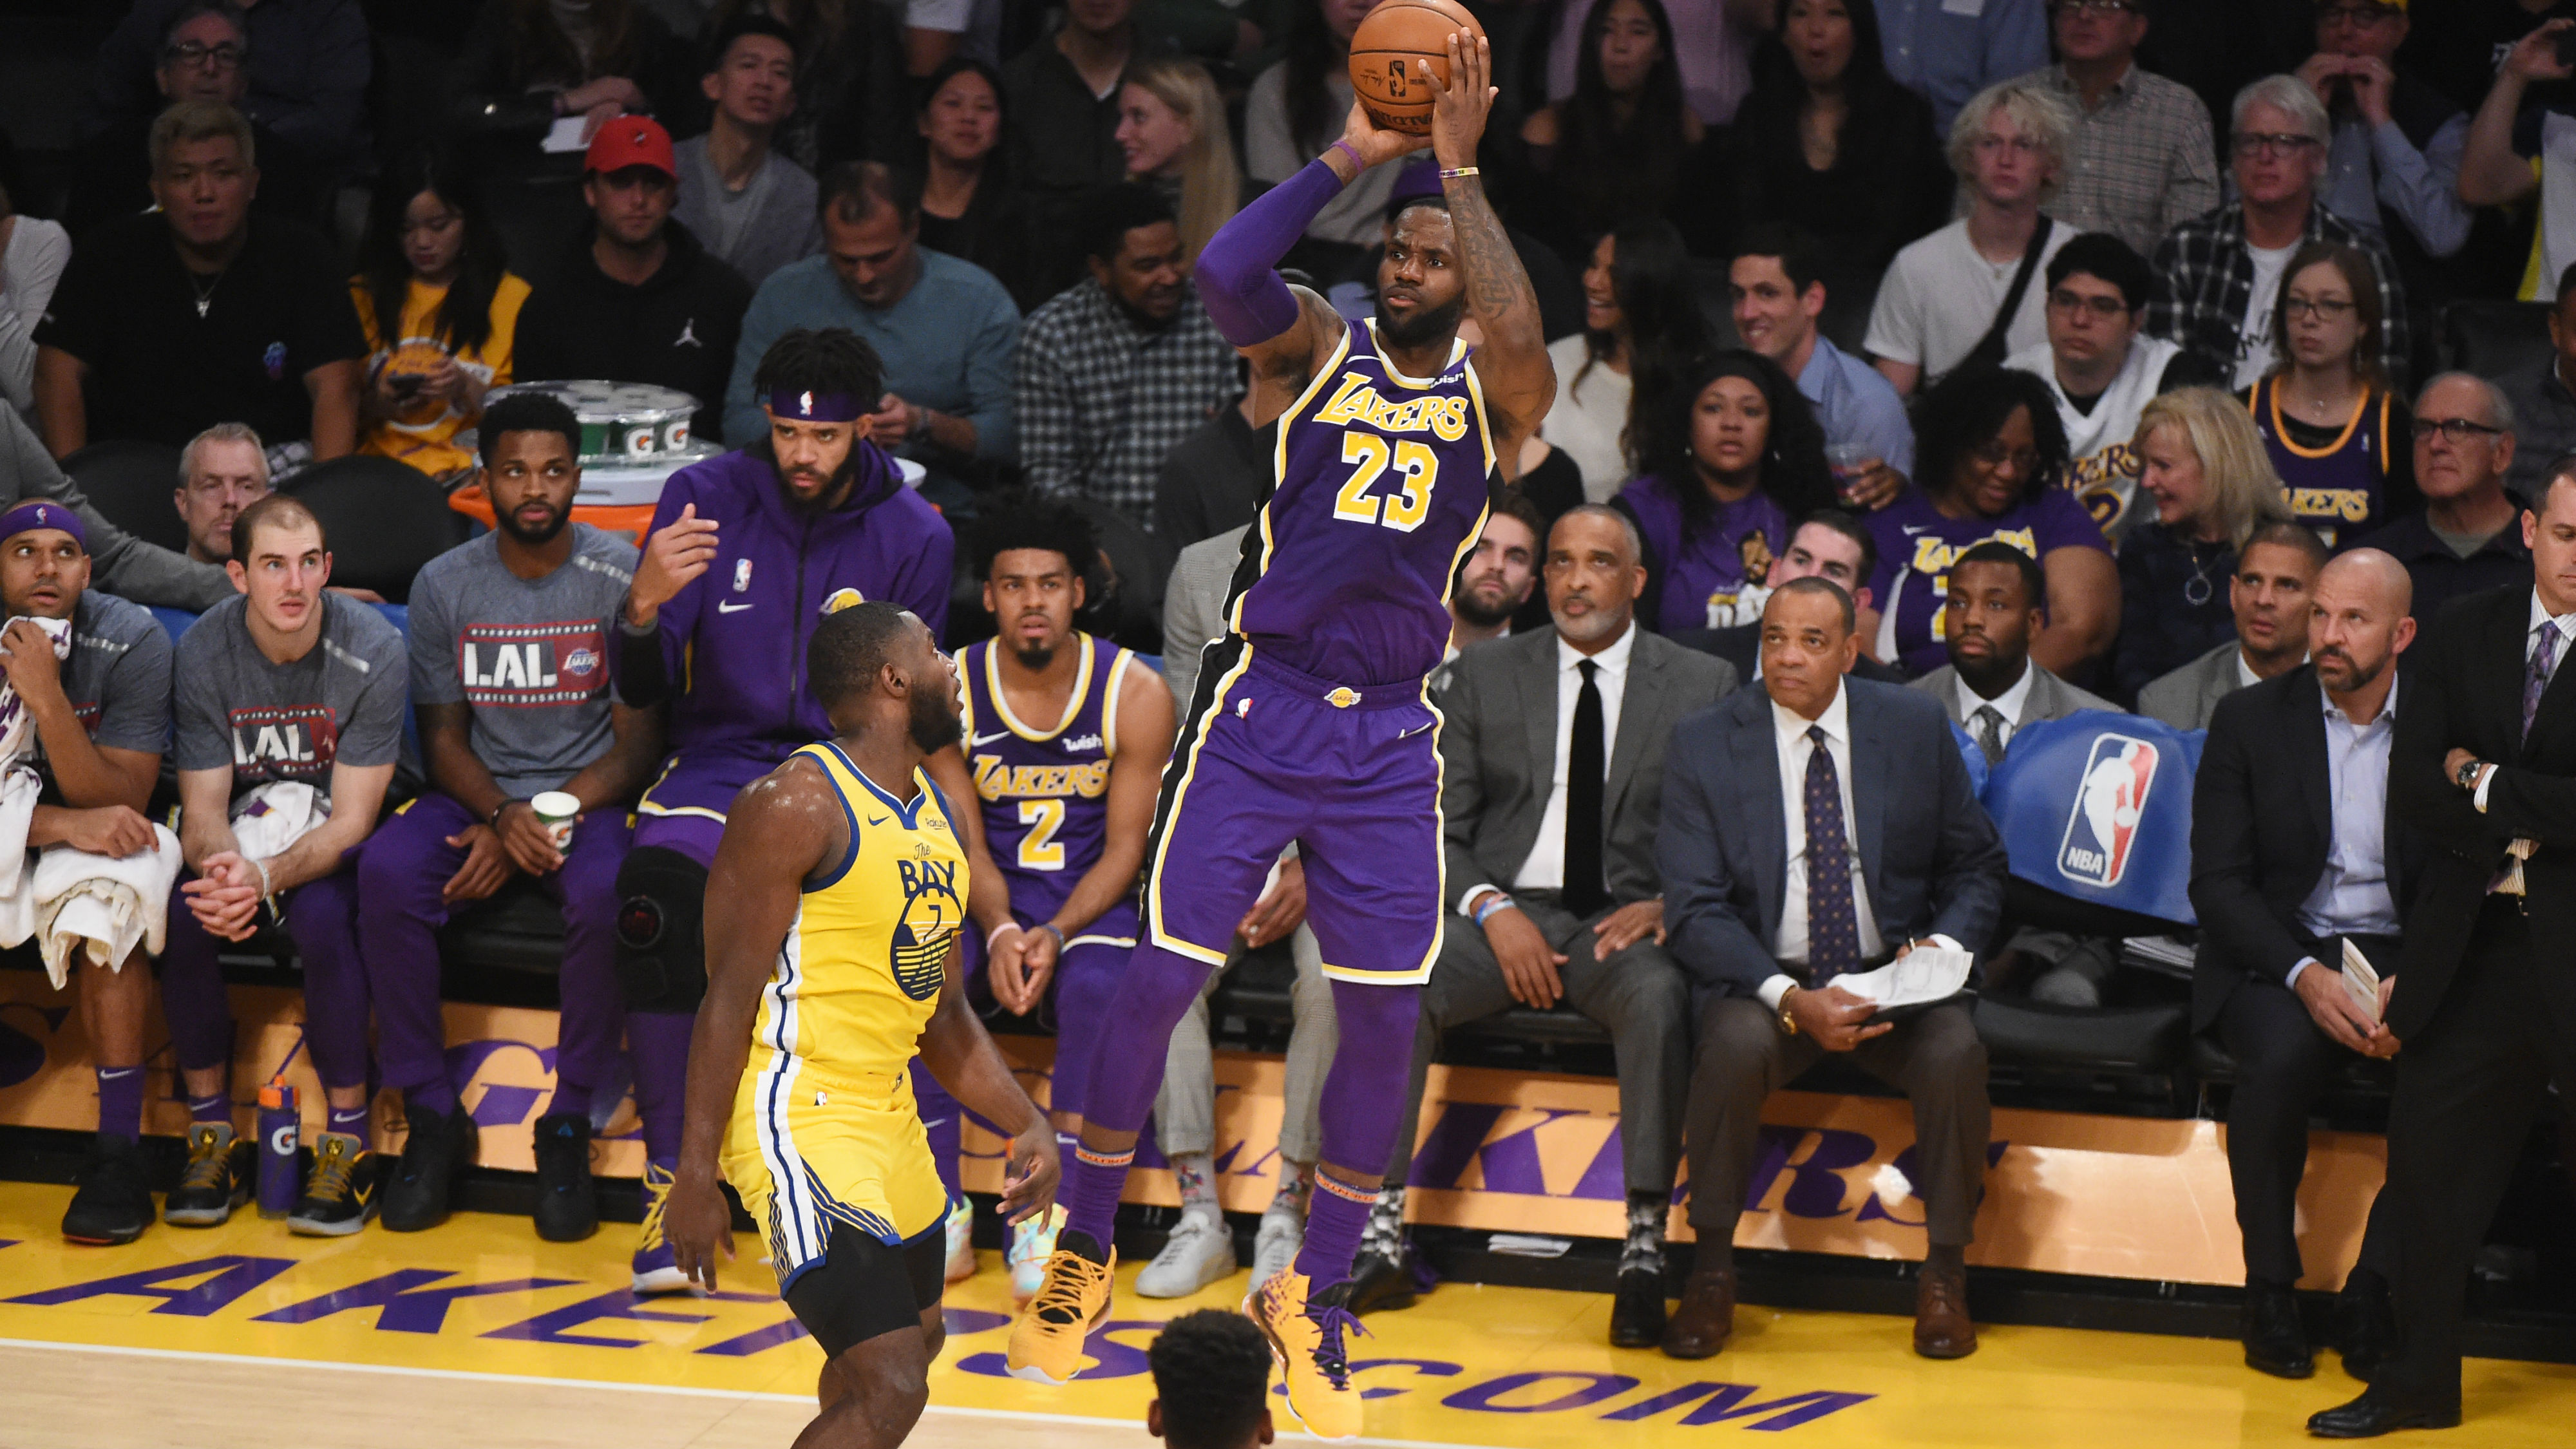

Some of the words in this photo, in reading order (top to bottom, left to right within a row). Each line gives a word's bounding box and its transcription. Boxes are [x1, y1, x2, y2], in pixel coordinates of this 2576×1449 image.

[1312, 372, 1469, 442] LAKERS
[1333, 430, 1439, 533] 23
[2280, 488, 2369, 523] KERS
[464, 642, 558, 688] LAL
[232, 724, 316, 765] LAL
[1062, 734, 1103, 752] wish
[974, 753, 1111, 802] LAKERS
[914, 842, 931, 860] The
[1018, 798, 1066, 871] 2
[896, 860, 956, 898] BAY
[2065, 846, 2104, 876] NBA
[923, 904, 942, 943] 7
[271, 1124, 296, 1156] G
